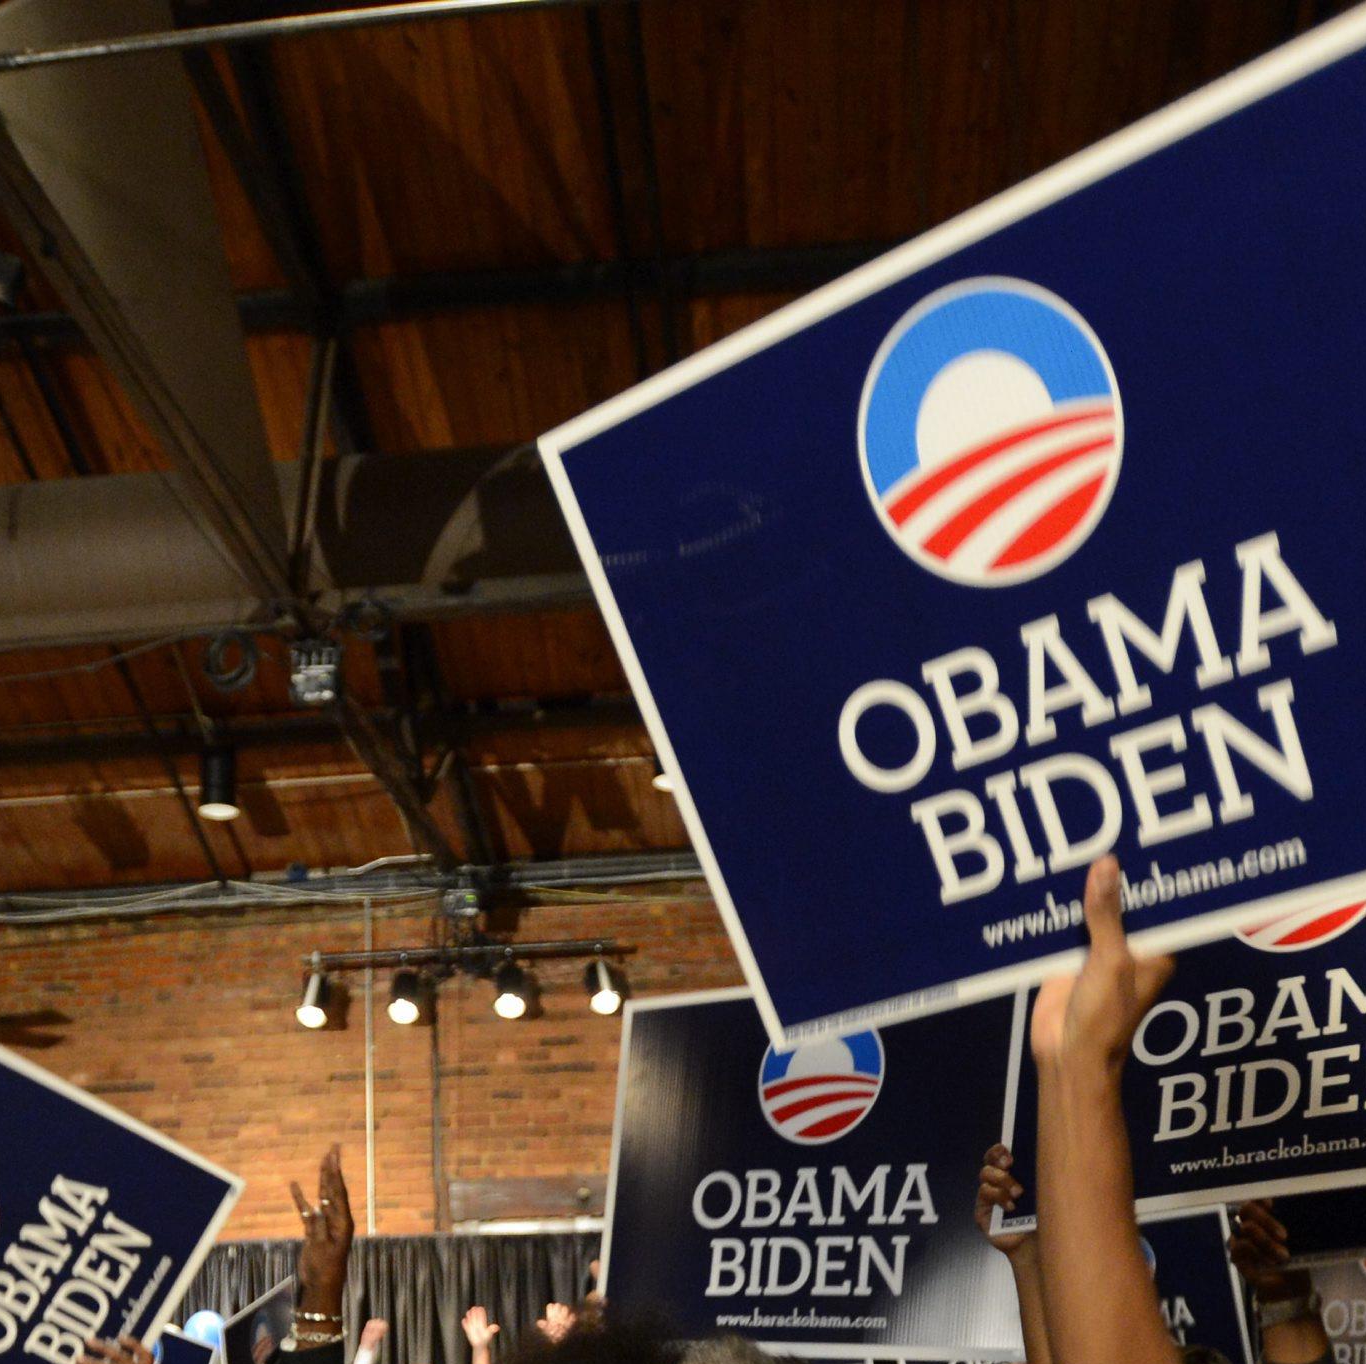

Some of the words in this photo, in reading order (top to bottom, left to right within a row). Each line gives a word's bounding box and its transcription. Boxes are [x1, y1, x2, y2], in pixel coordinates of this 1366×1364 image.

[838, 530, 1339, 795] OBAMA
[911, 678, 1314, 907] BIDEN
[982, 836, 1298, 949] www.bakobama.com
[692, 1163, 939, 1230] OBAMA
[704, 1235, 910, 1297] BIDEN
[716, 1306, 887, 1329] www.barackobama.com
